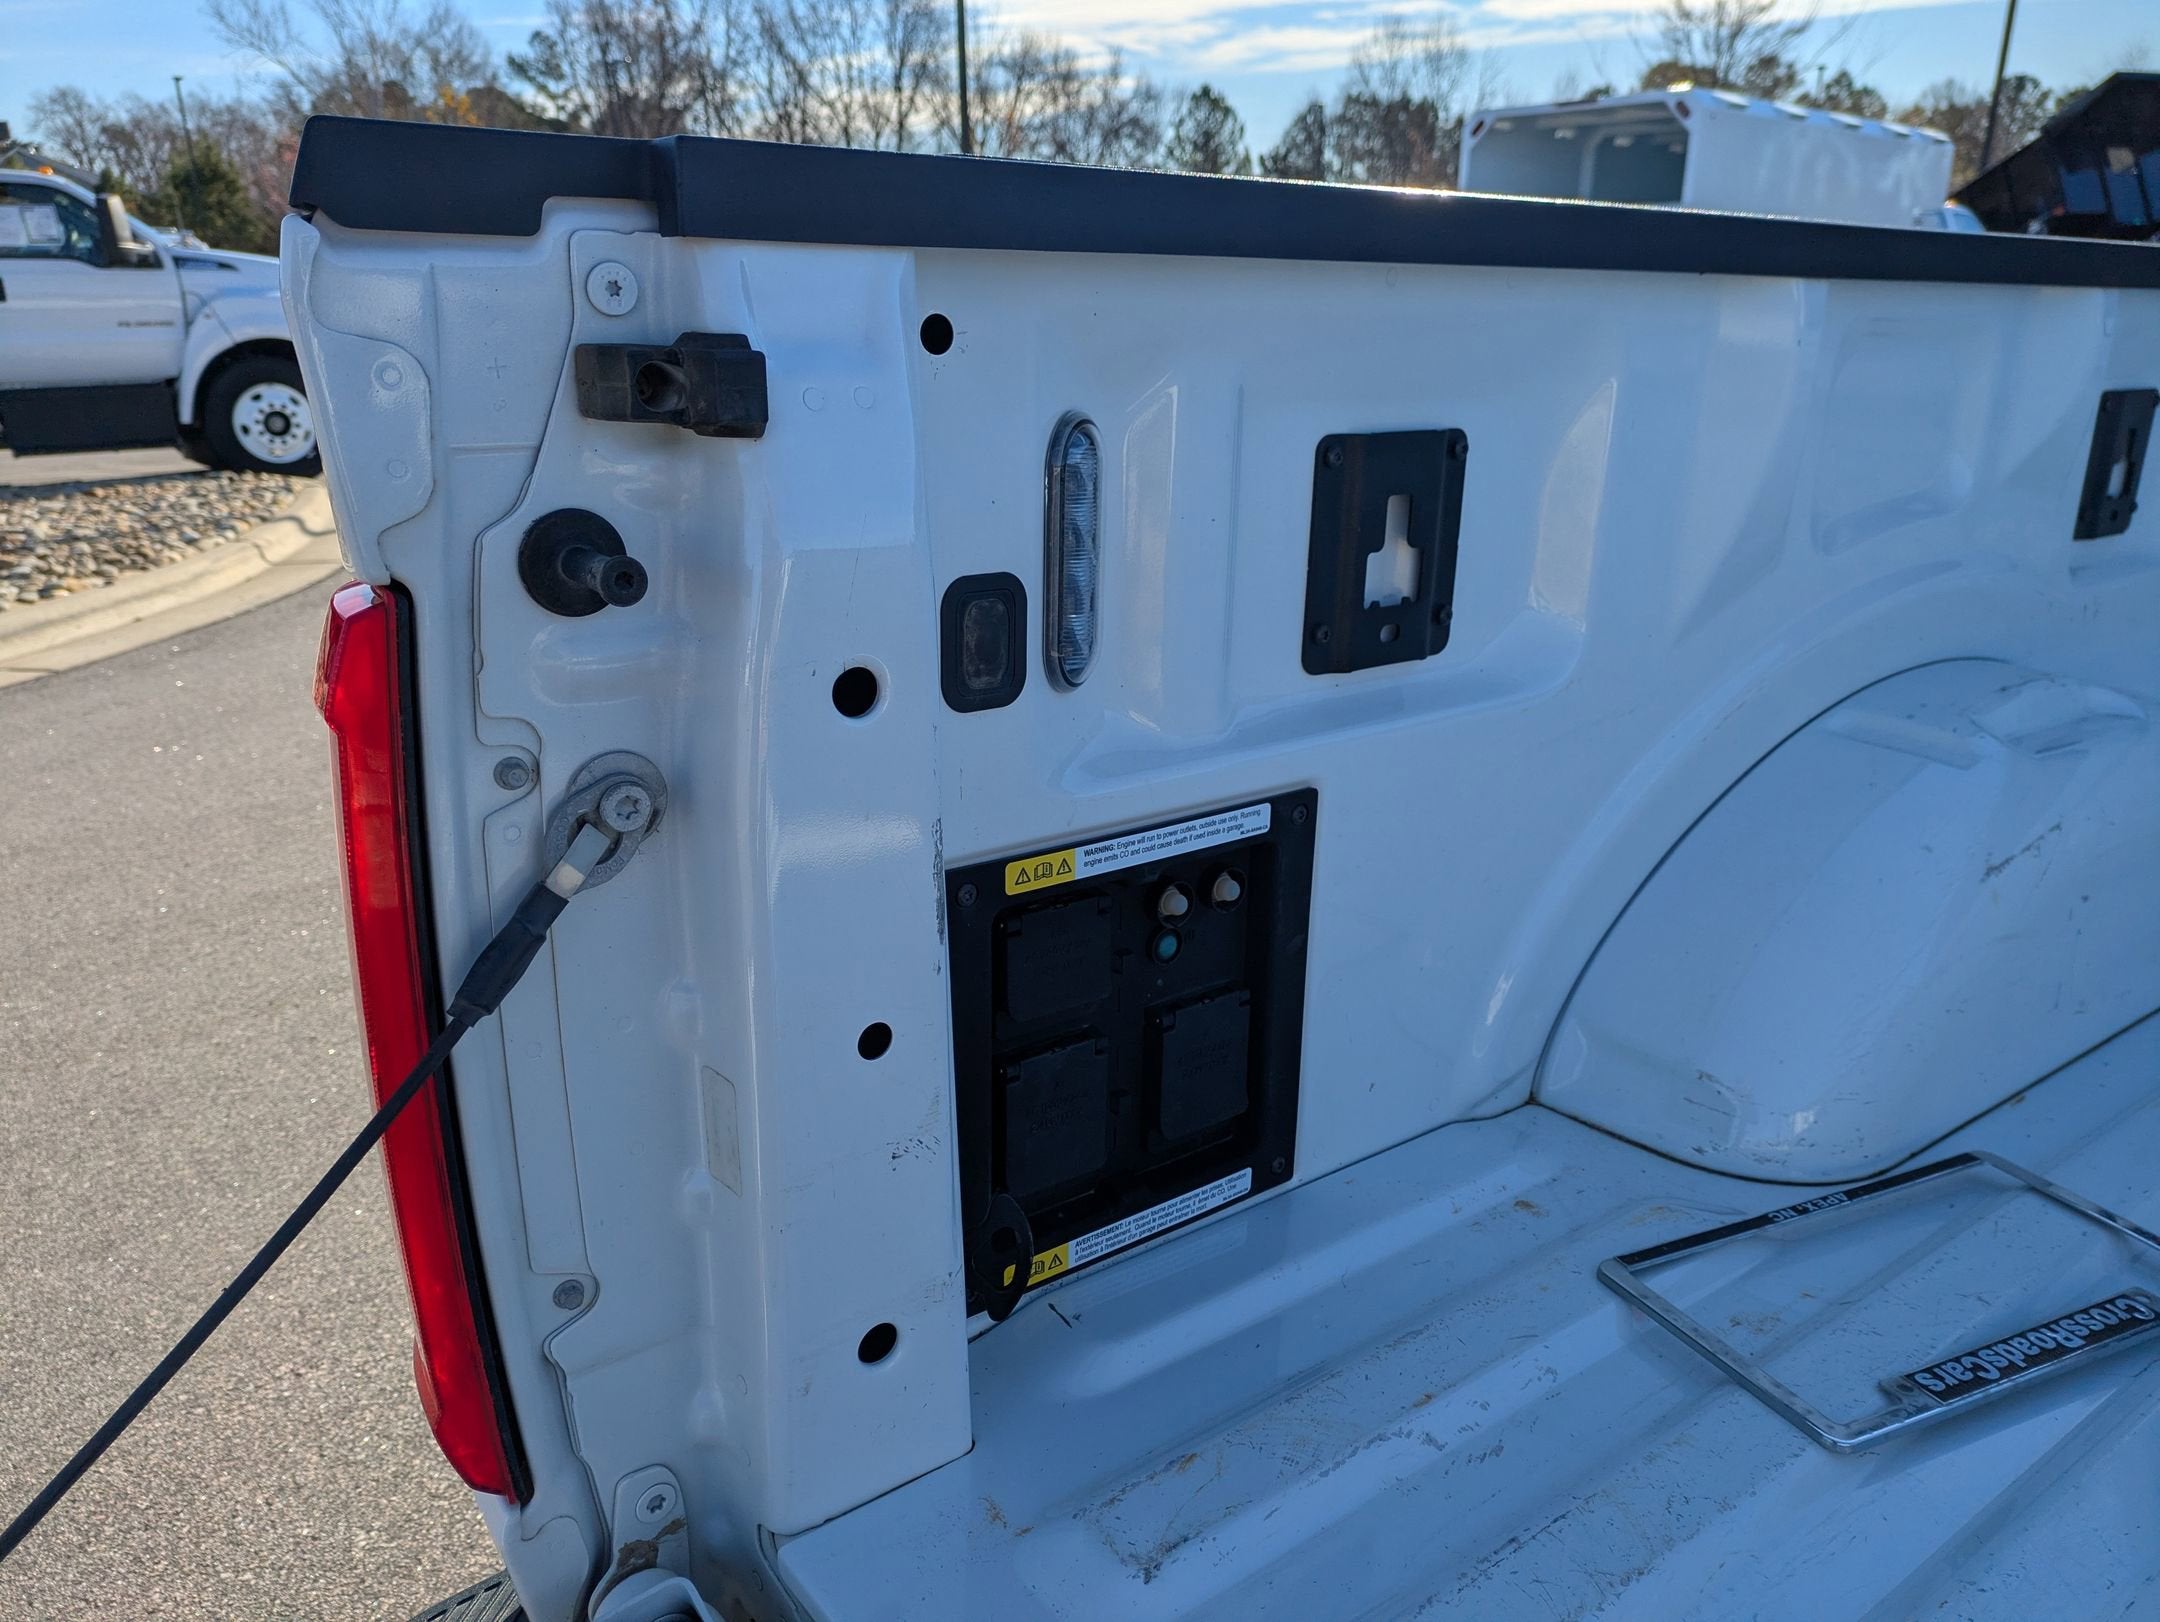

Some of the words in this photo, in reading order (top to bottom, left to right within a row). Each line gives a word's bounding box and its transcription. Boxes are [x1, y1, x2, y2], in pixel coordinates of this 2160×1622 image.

[1084, 844, 1116, 857] WARNING:
[1117, 840, 1135, 851] Engine
[1137, 837, 1146, 845] will
[1157, 832, 1162, 840] to
[1163, 831, 1179, 840] power
[1180, 824, 1198, 834] outlets,
[1199, 819, 1217, 830] outside
[1218, 817, 1227, 825] use
[1240, 809, 1261, 819] Running
[1084, 857, 1102, 867] engine
[1104, 854, 1119, 862] emits
[1120, 850, 1129, 859] CO
[1130, 847, 1141, 856] and
[1142, 844, 1156, 853] could
[1157, 841, 1173, 849] cause
[1174, 836, 1188, 846] death
[1194, 831, 1206, 840] used
[1207, 828, 1221, 837] inside
[1075, 1222, 1124, 1248] AVERTISSEMENT:
[1124, 1219, 1132, 1227] Le
[1132, 1212, 1149, 1224] moteur
[1150, 1205, 1166, 1217] tourne
[1167, 1200, 1178, 1211] pour
[1179, 1191, 1201, 1205] alimenter
[1134, 1219, 1151, 1231] Quand
[1157, 1209, 1175, 1222] moteur
[1210, 1191, 1217, 1199] du
[1227, 1183, 1237, 1191] Une
[1766, 1205, 1796, 1222] NC
[1797, 1191, 1848, 1215] APEX,
[1075, 1247, 1099, 1263] utilisation
[1139, 1225, 1156, 1238] garage
[1157, 1219, 1168, 1230] peut
[1912, 1296, 2156, 1393] CrossRoadsCars
